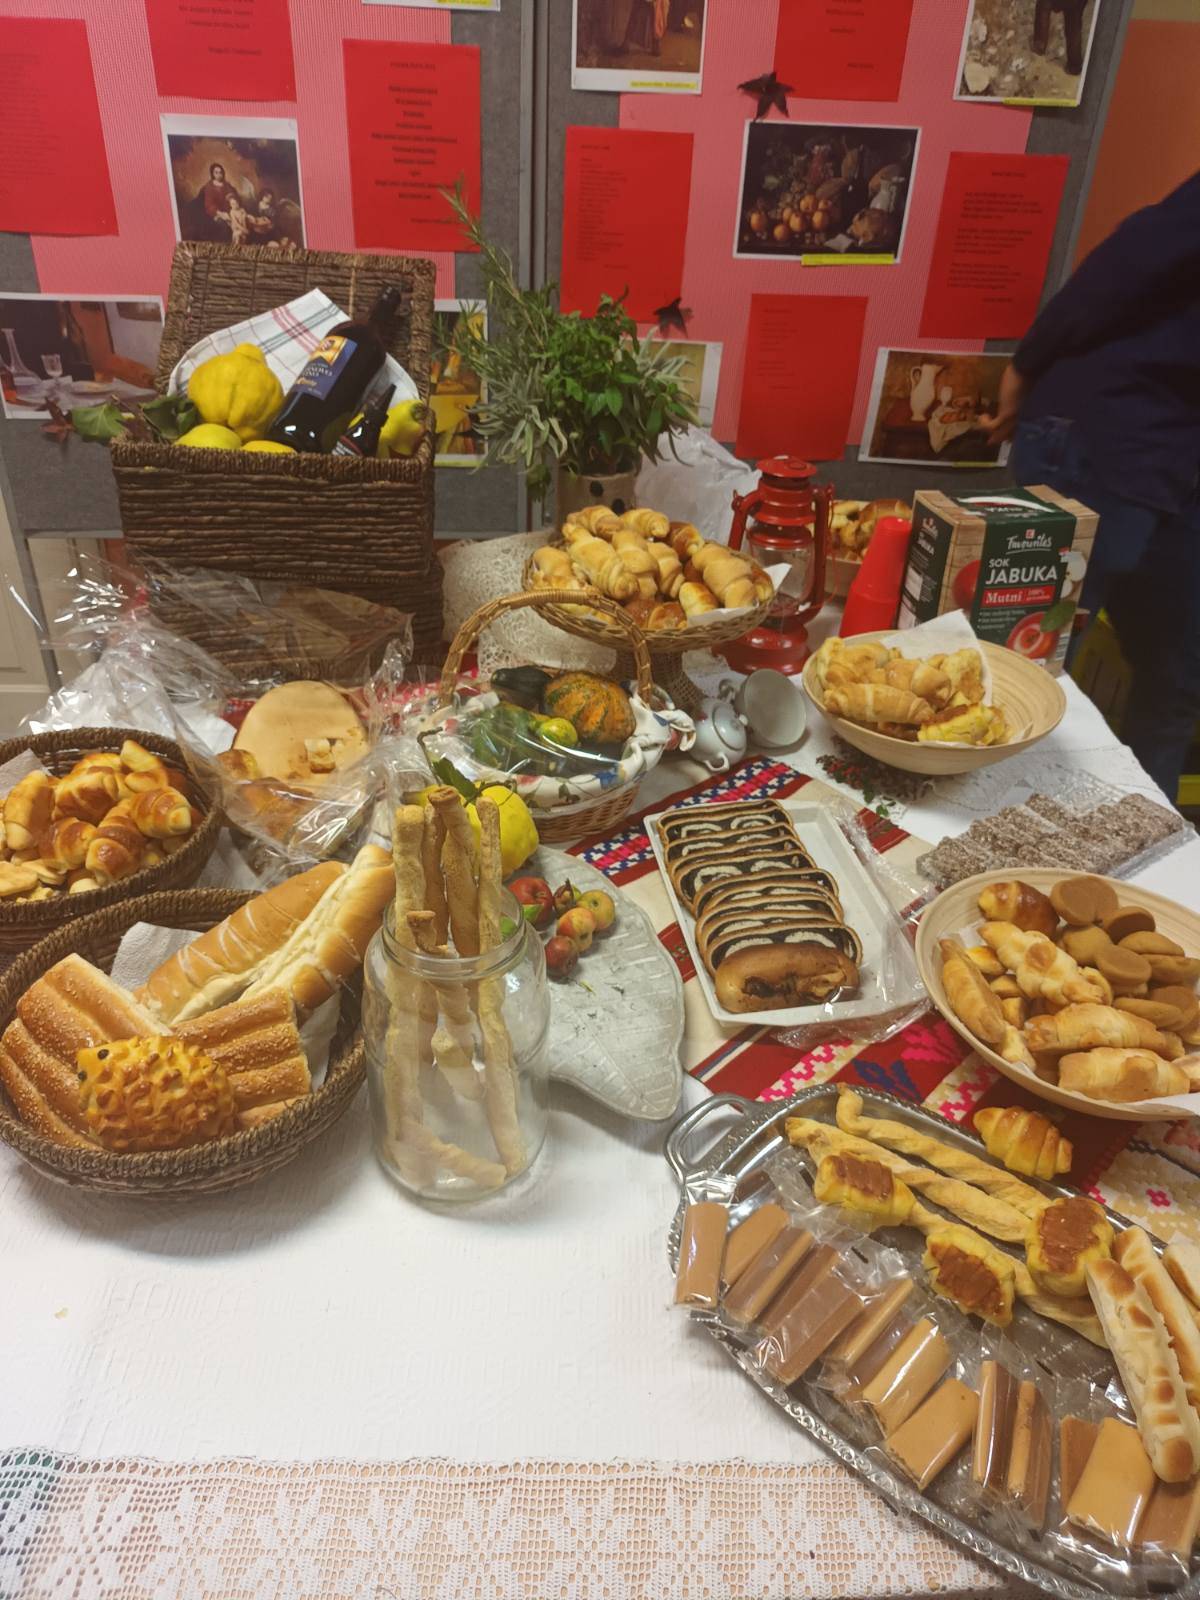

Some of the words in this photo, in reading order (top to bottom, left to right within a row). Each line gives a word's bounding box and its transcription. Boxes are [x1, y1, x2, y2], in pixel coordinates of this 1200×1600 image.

[1006, 533, 1052, 550] Favourites
[988, 558, 1010, 568] SOK
[985, 565, 1058, 585] JABUKA
[985, 590, 1023, 604] Mutni
